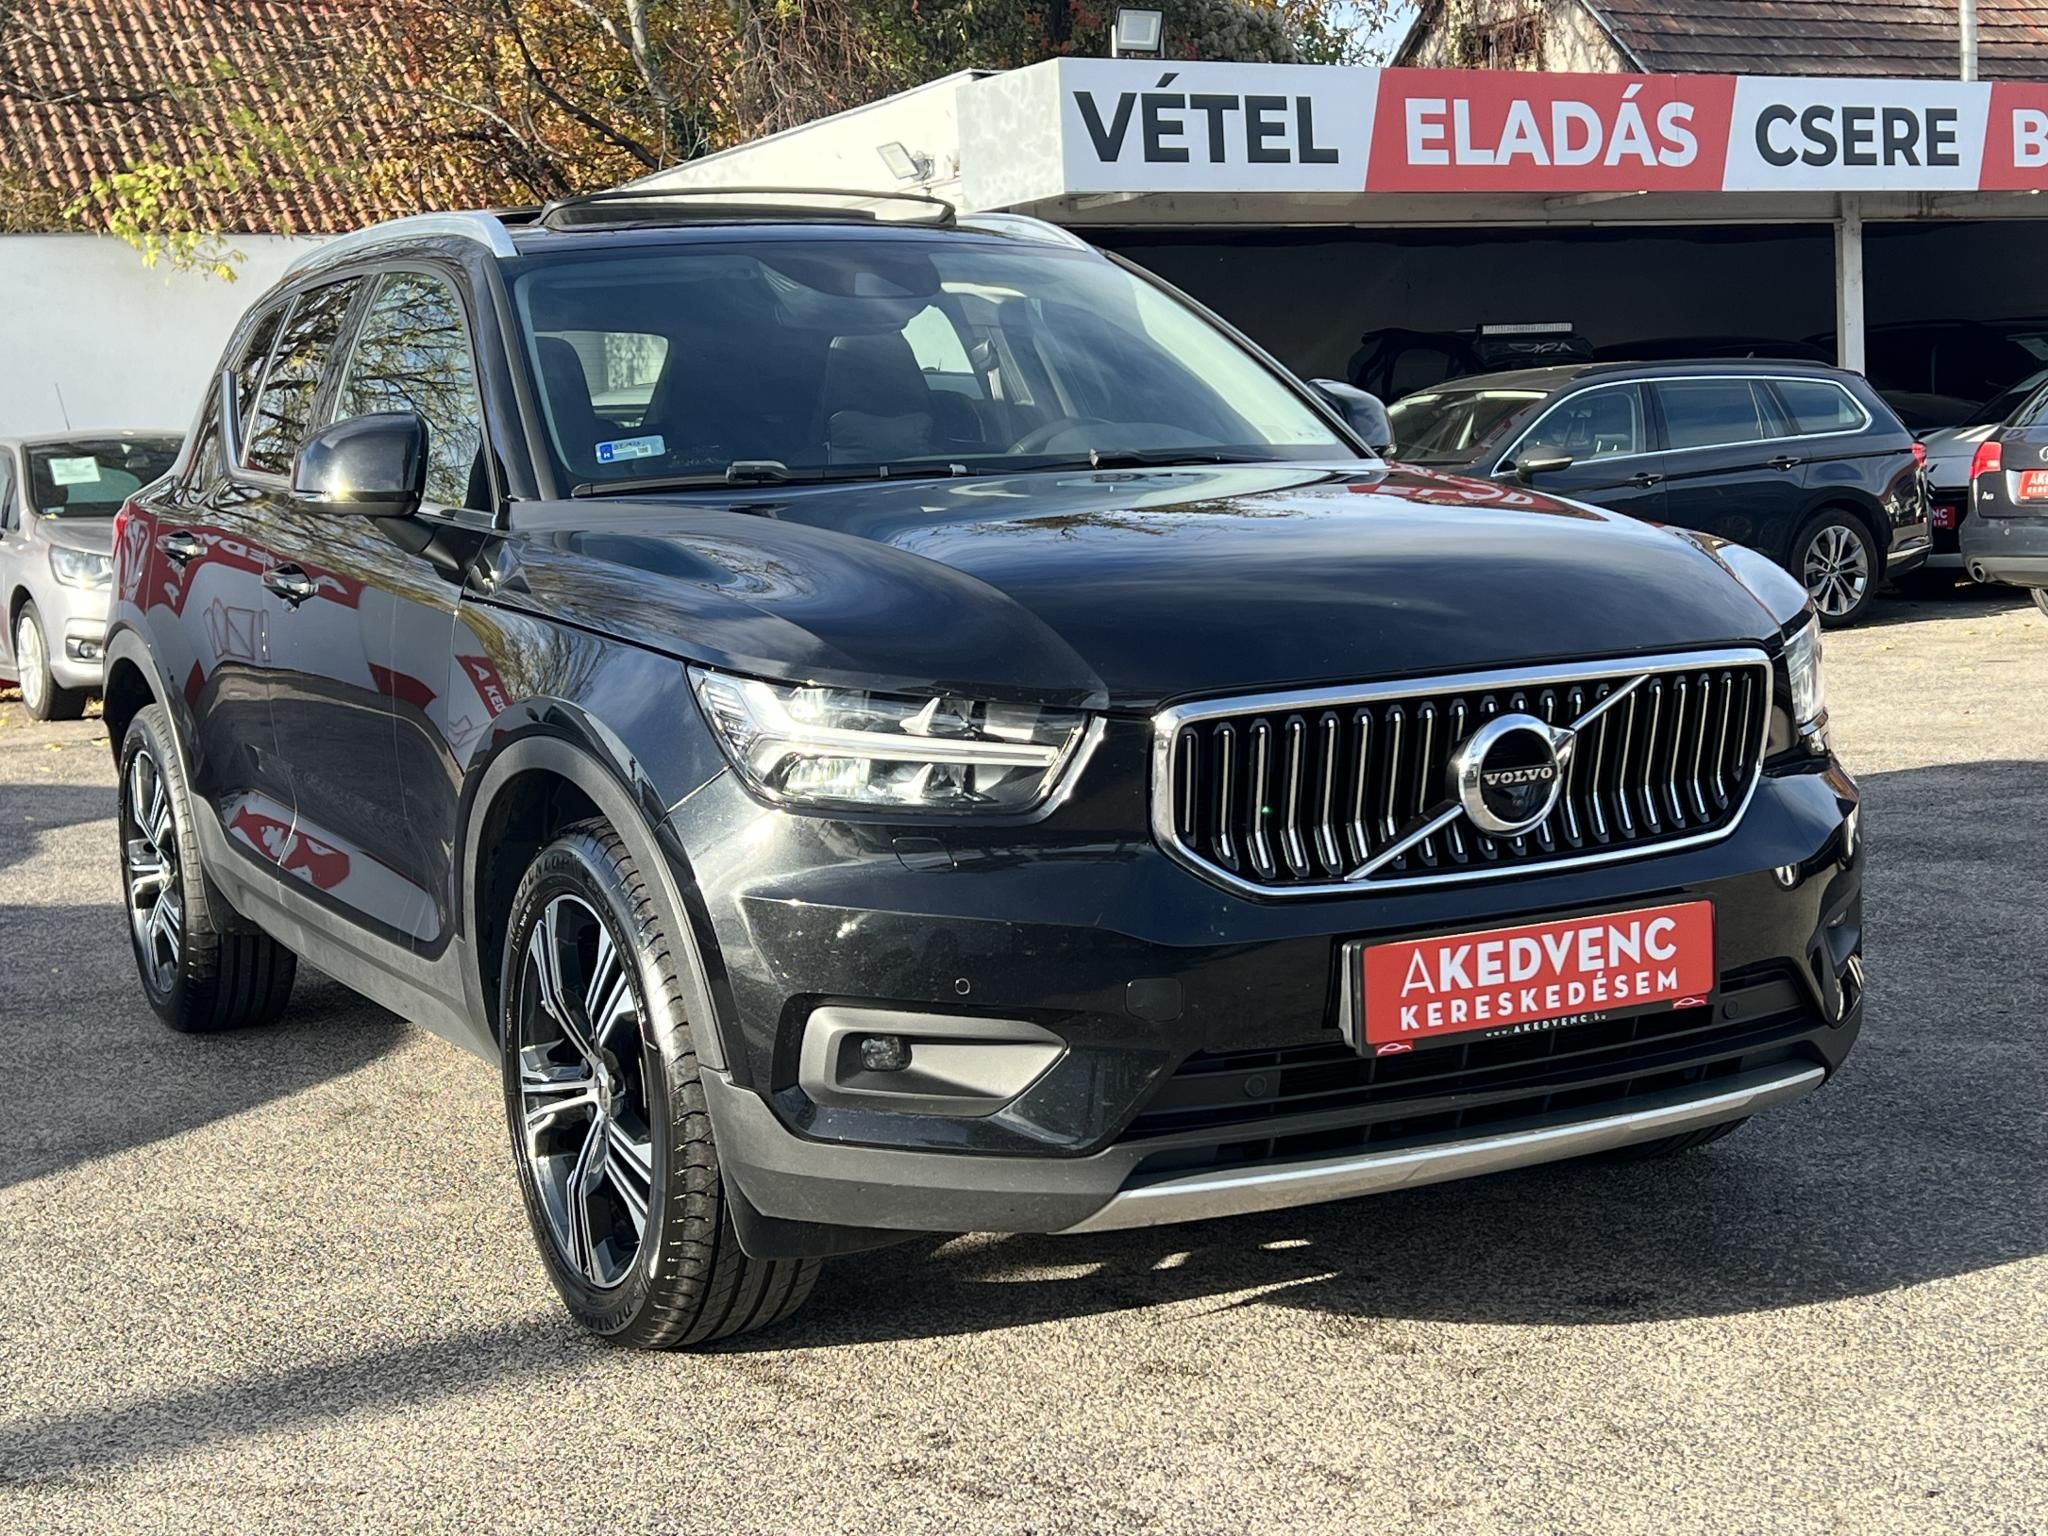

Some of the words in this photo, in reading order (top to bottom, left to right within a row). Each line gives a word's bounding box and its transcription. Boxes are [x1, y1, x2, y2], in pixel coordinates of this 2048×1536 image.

[1072, 72, 1339, 164] VÉTEL
[1404, 83, 1698, 168] ELADÁS
[1755, 104, 1960, 167] CSERE
[1483, 766, 1553, 786] VOLVO
[1400, 916, 1677, 998] AKEDVENC
[1400, 967, 1678, 1031] KERESKEDÉSEM
